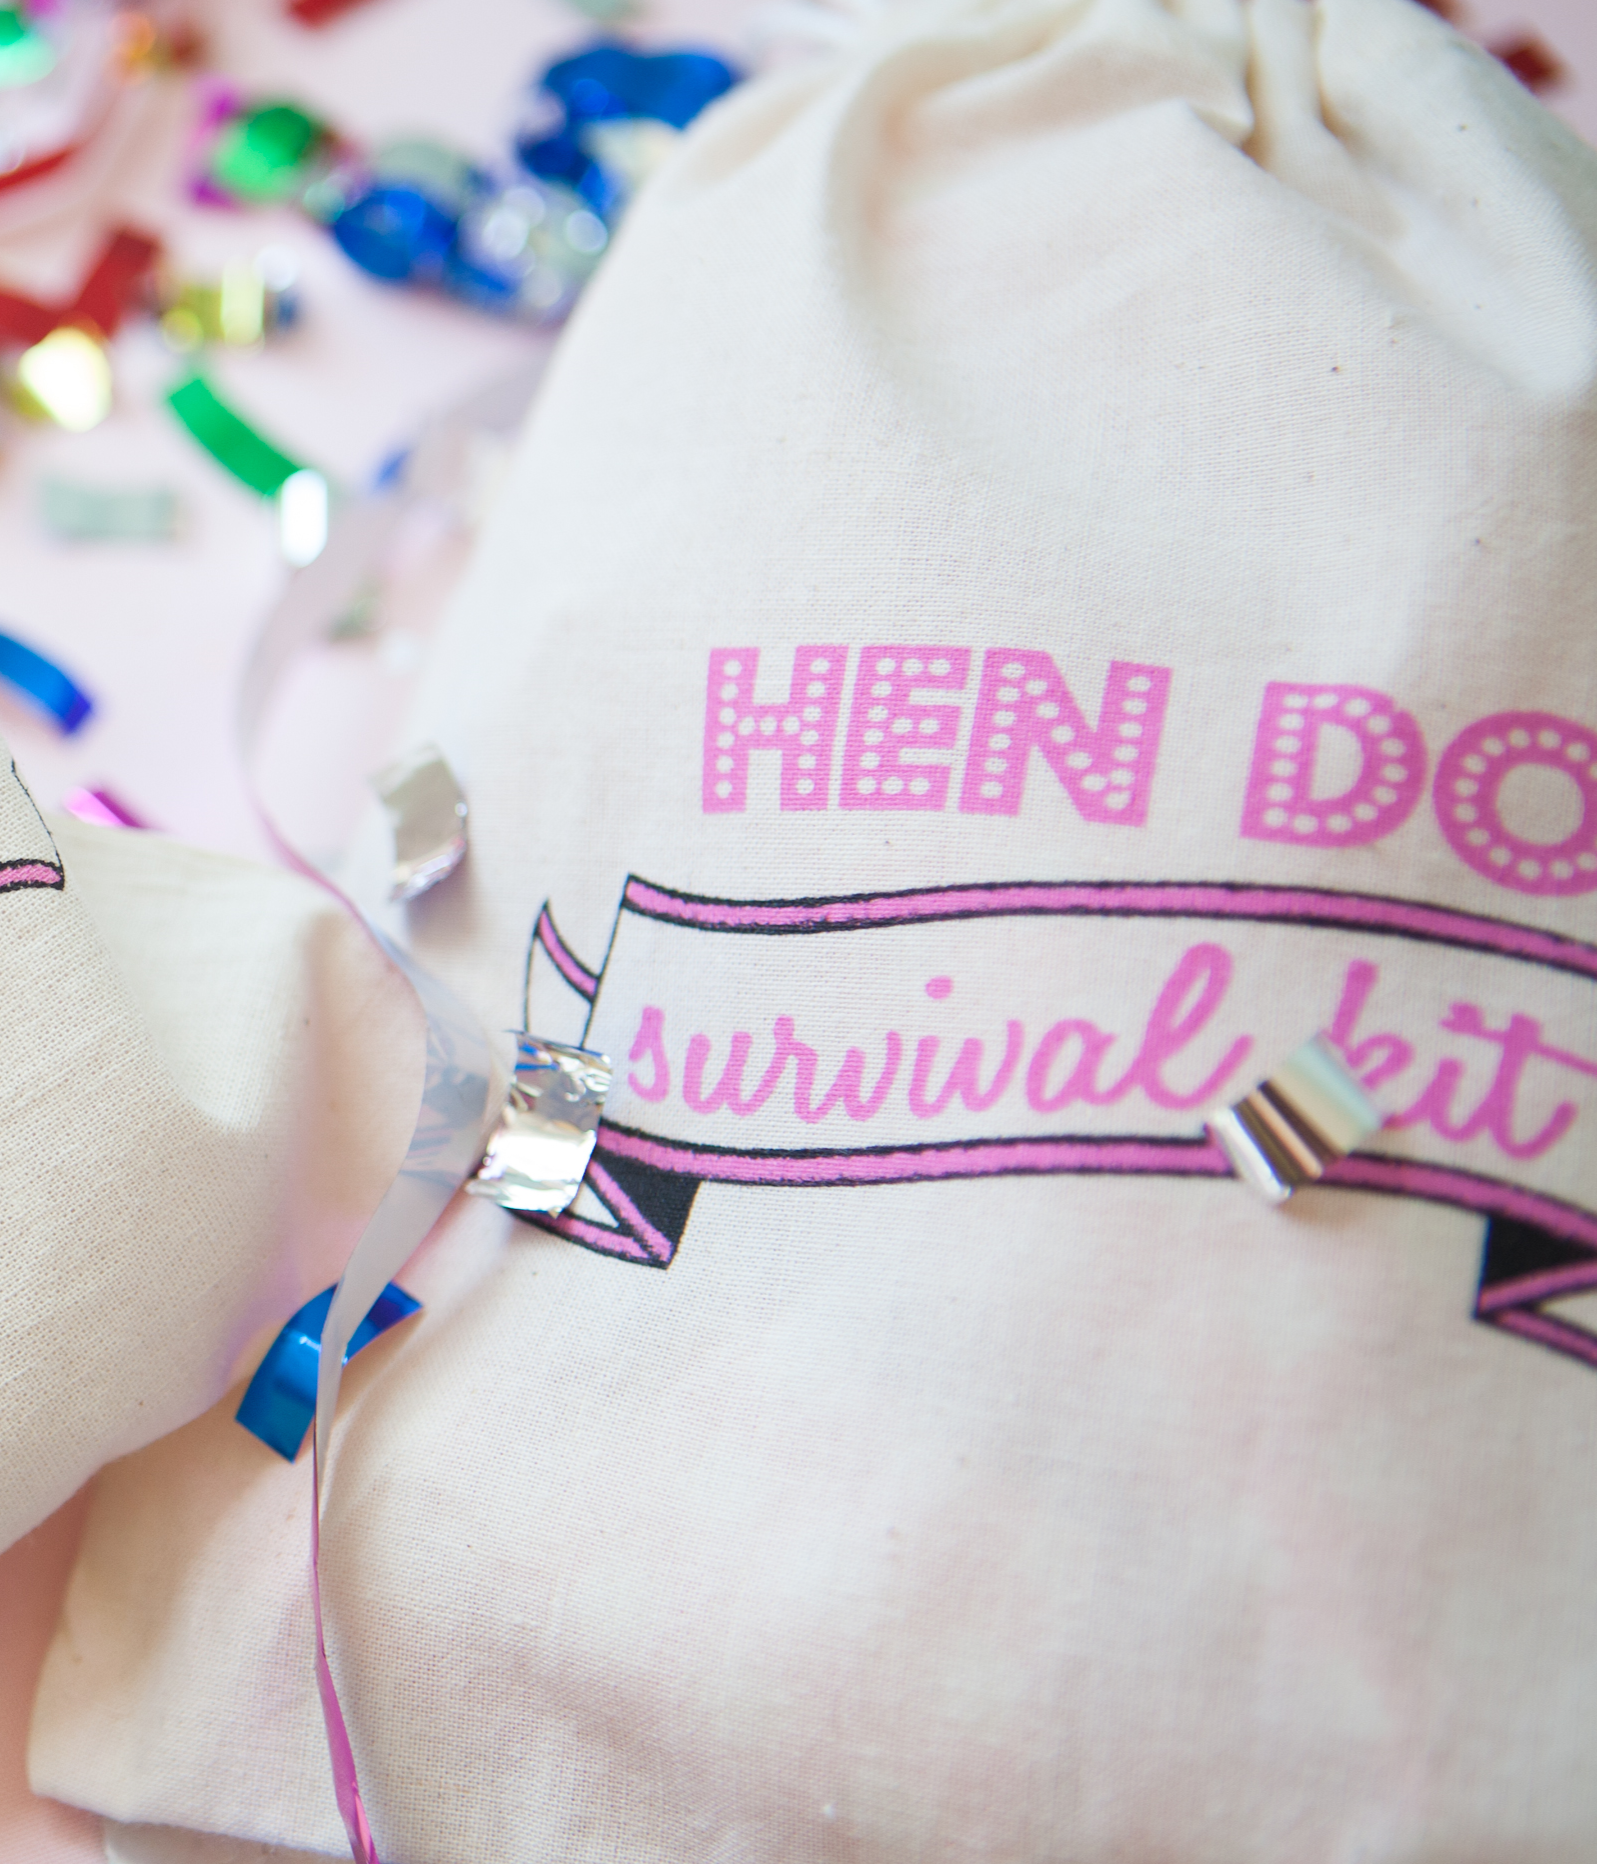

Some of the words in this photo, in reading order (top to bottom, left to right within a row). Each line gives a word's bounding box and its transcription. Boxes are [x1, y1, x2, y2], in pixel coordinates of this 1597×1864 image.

[701, 643, 1173, 828] HEN
[1239, 681, 1597, 898] DO
[627, 941, 1255, 1124] survival
